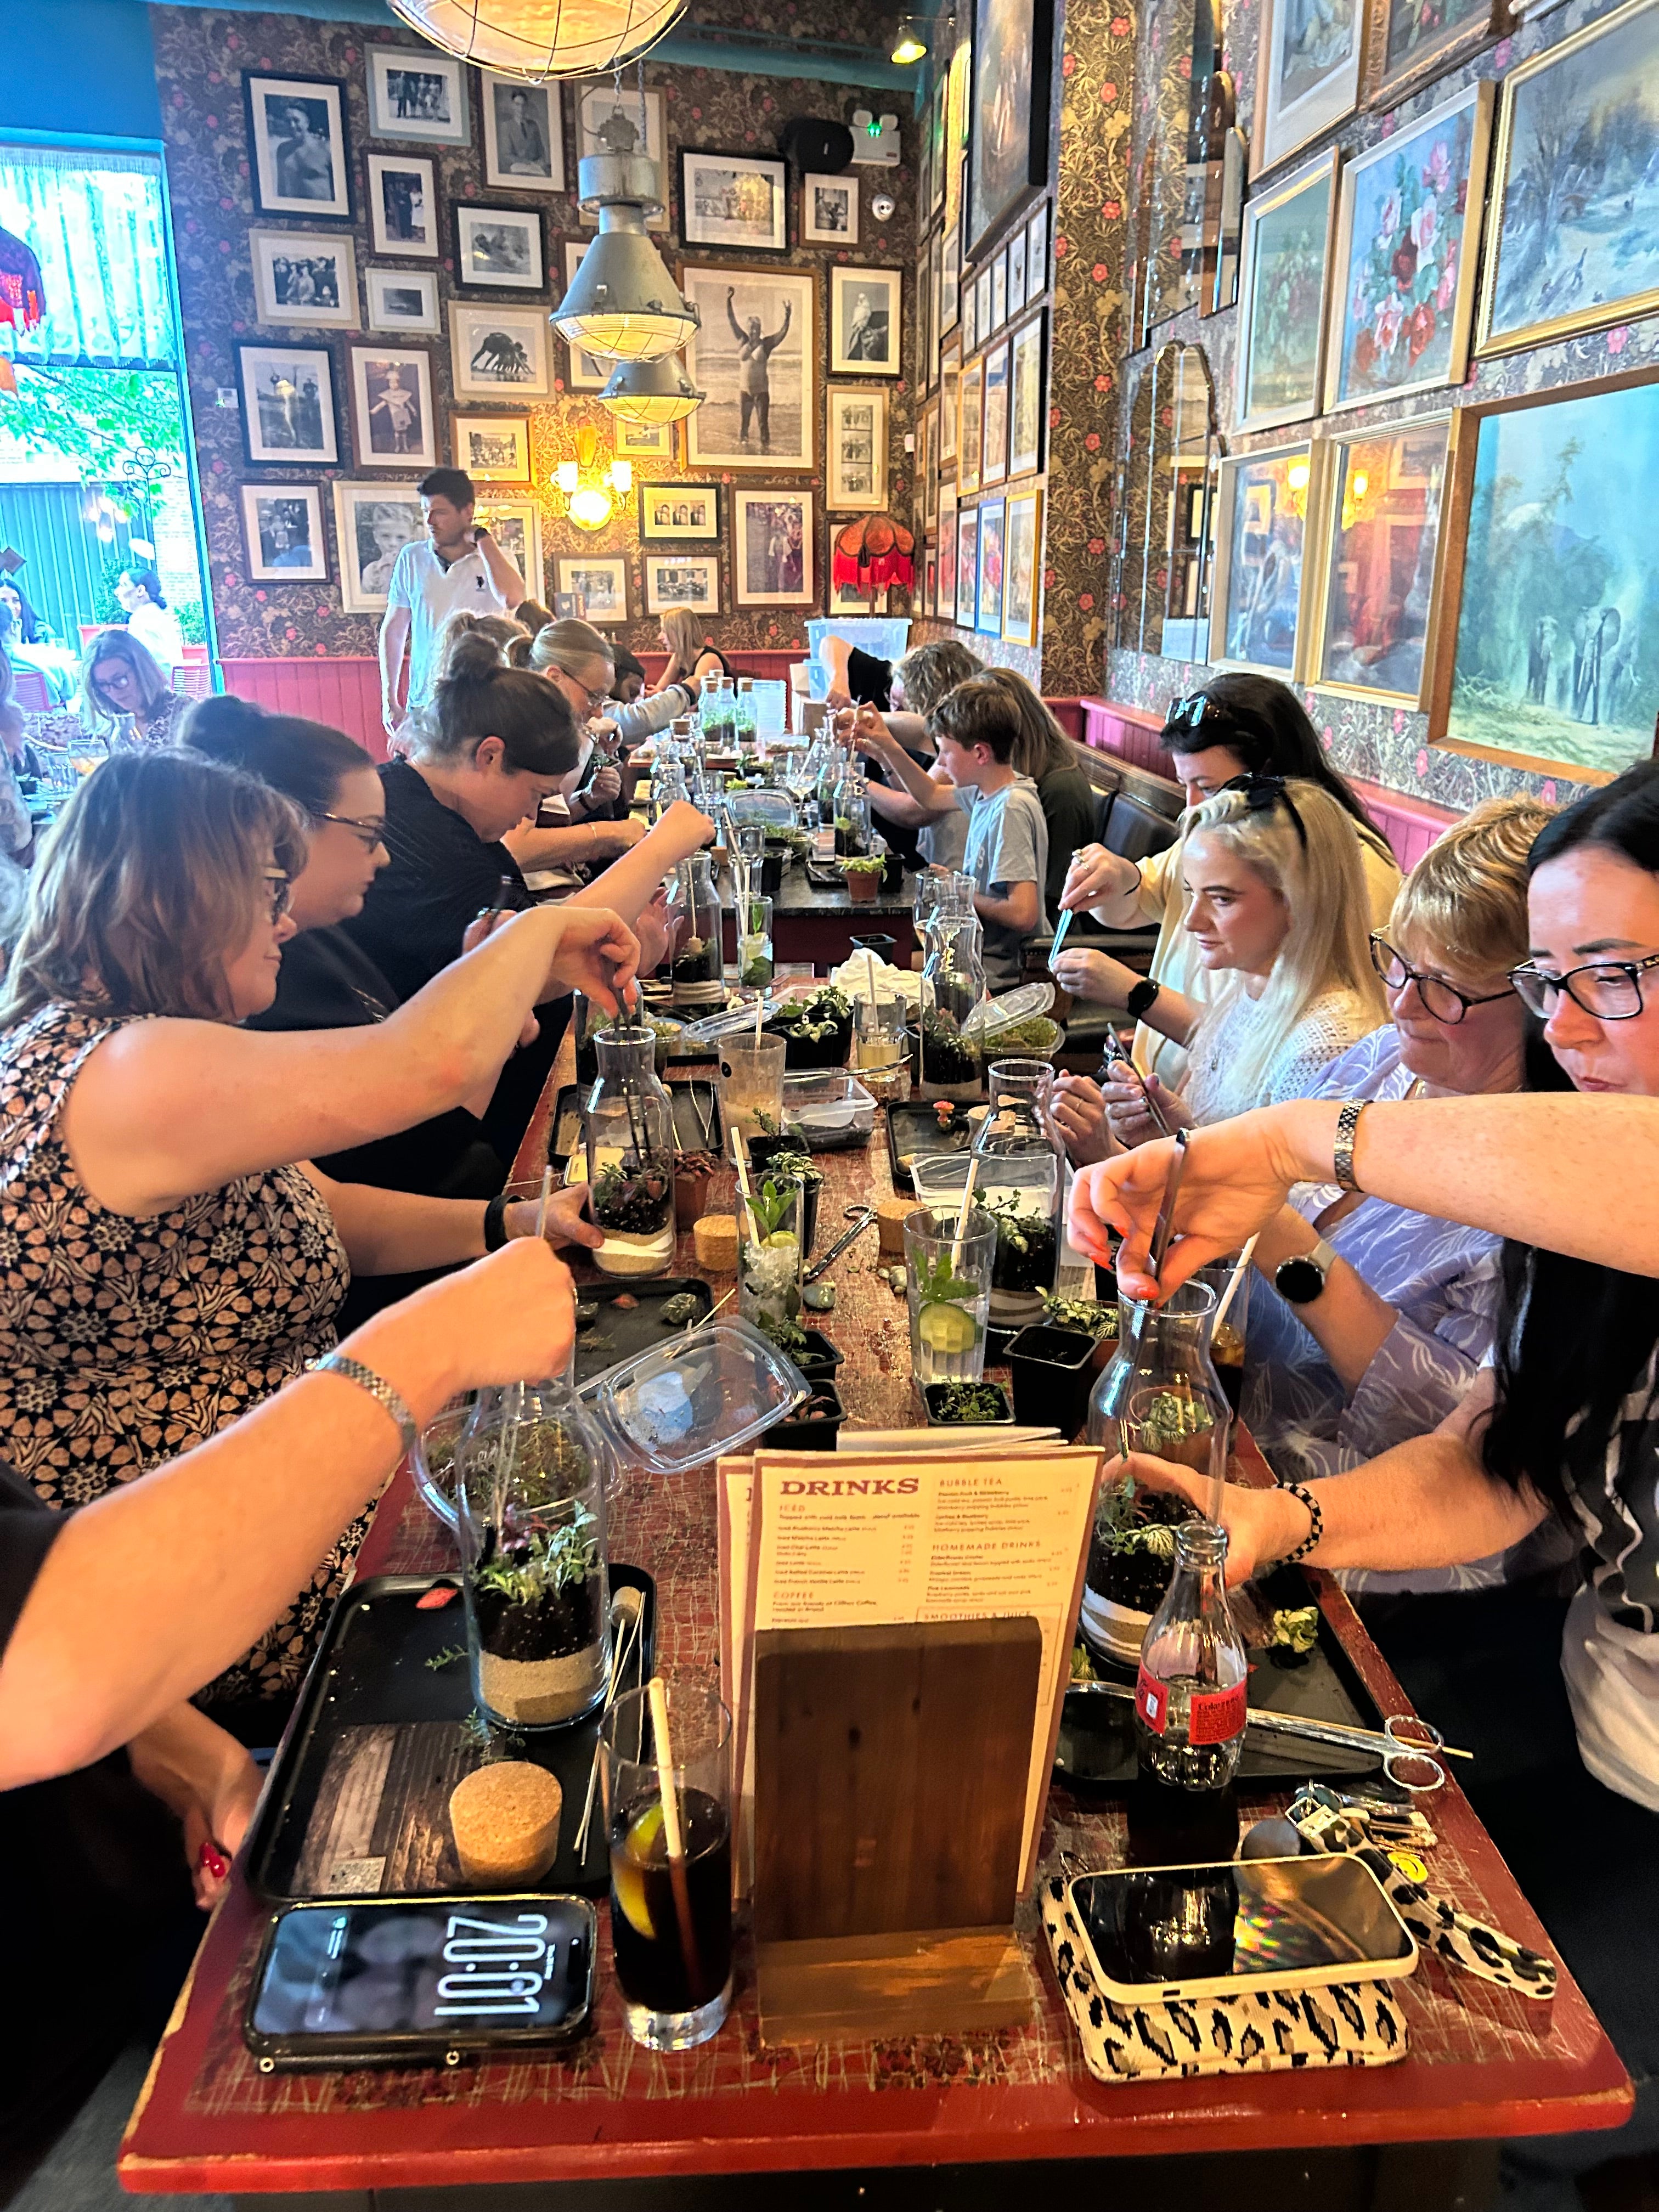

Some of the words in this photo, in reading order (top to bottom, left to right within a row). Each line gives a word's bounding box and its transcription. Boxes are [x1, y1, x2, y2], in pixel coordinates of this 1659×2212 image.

[780, 1478, 919, 1496] DRINKS
[933, 1543, 996, 1551] HOMEMADE
[1002, 1540, 1041, 1550] DRINKS
[434, 1914, 548, 2016] 20:01
